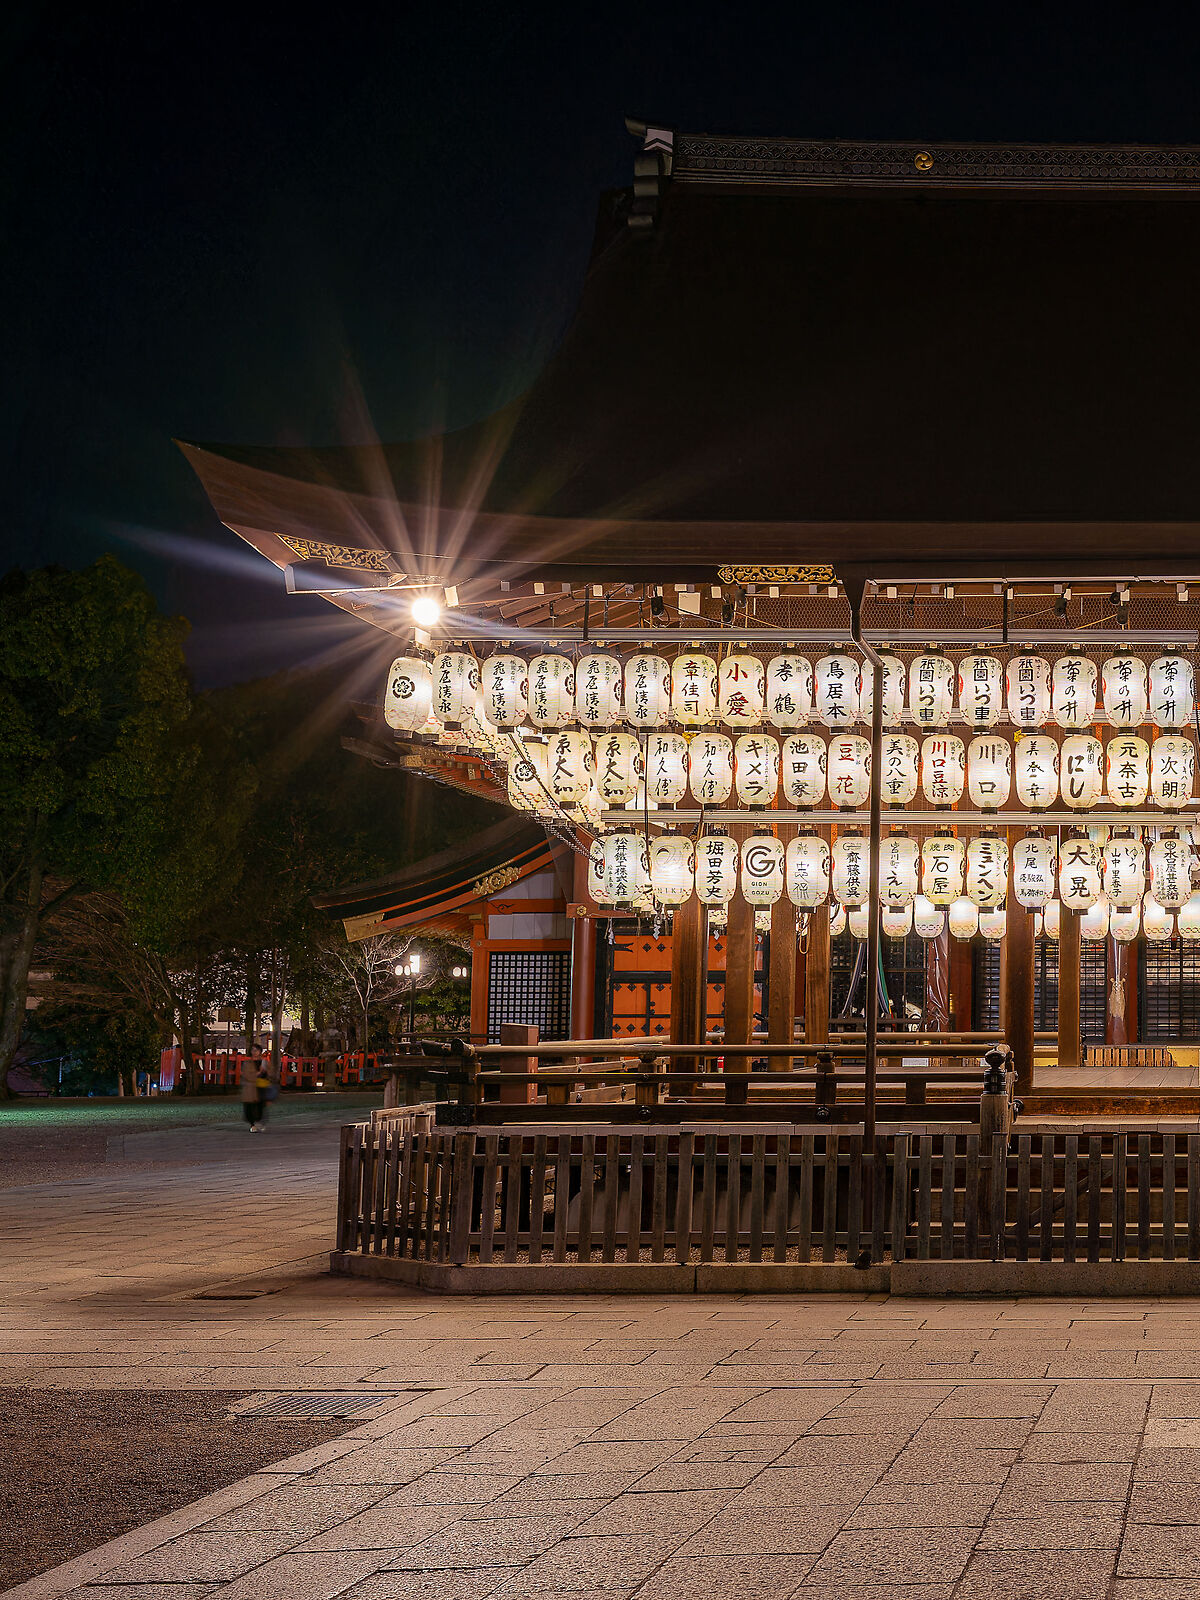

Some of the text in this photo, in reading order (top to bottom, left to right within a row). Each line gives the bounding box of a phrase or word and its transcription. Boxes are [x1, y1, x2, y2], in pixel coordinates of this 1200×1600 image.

[726, 662, 750, 717] 小愛
[773, 660, 796, 715] 孝鶴
[826, 660, 847, 719] 鳥居本
[745, 740, 764, 796] キメラ
[790, 739, 810, 797] 池田家
[835, 743, 854, 795] 豆花
[886, 739, 906, 795] 美の八重
[978, 744, 996, 795] 川口
[1067, 755, 1084, 798] にし
[1117, 742, 1138, 798] 元奈古
[1160, 756, 1178, 798] 次朗
[705, 841, 724, 898] 堀田芳史
[1023, 843, 1039, 869] 北尾
[1067, 845, 1091, 898] 大晃
[1111, 848, 1121, 897] 山中里香子
